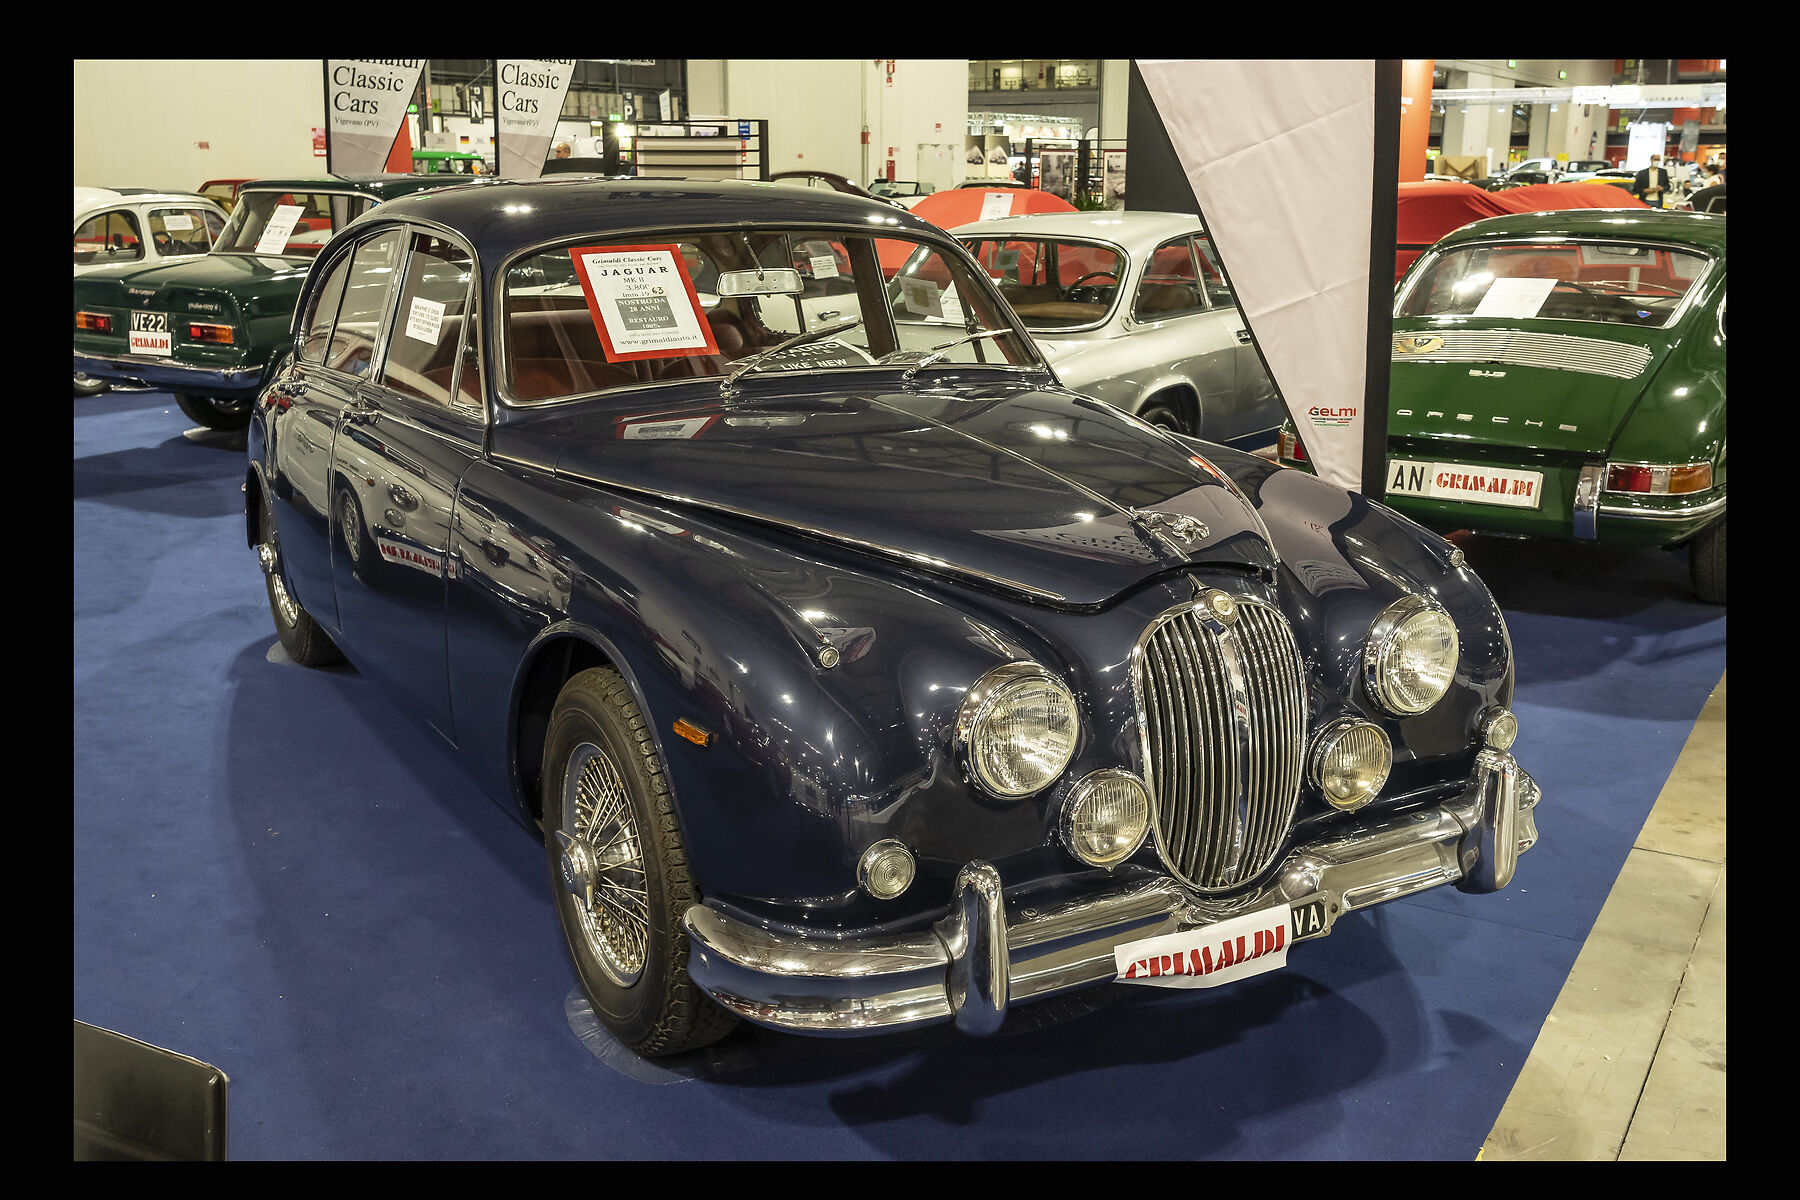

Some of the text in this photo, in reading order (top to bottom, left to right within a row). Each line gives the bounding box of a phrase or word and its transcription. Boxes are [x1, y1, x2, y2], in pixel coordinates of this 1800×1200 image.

[333, 65, 404, 92] Classic
[501, 63, 560, 90] Classic
[333, 91, 379, 115] Cars
[470, 100, 483, 119] N
[502, 90, 539, 114] Cars
[624, 104, 633, 120] P
[601, 266, 669, 277] JAGUAR
[619, 298, 653, 306] NOSTRO
[130, 337, 169, 349] GRIMALDI
[780, 358, 848, 371] LIKE NEW
[1392, 464, 1534, 497] AN GRIMALDI
[1293, 904, 1321, 936] VA
